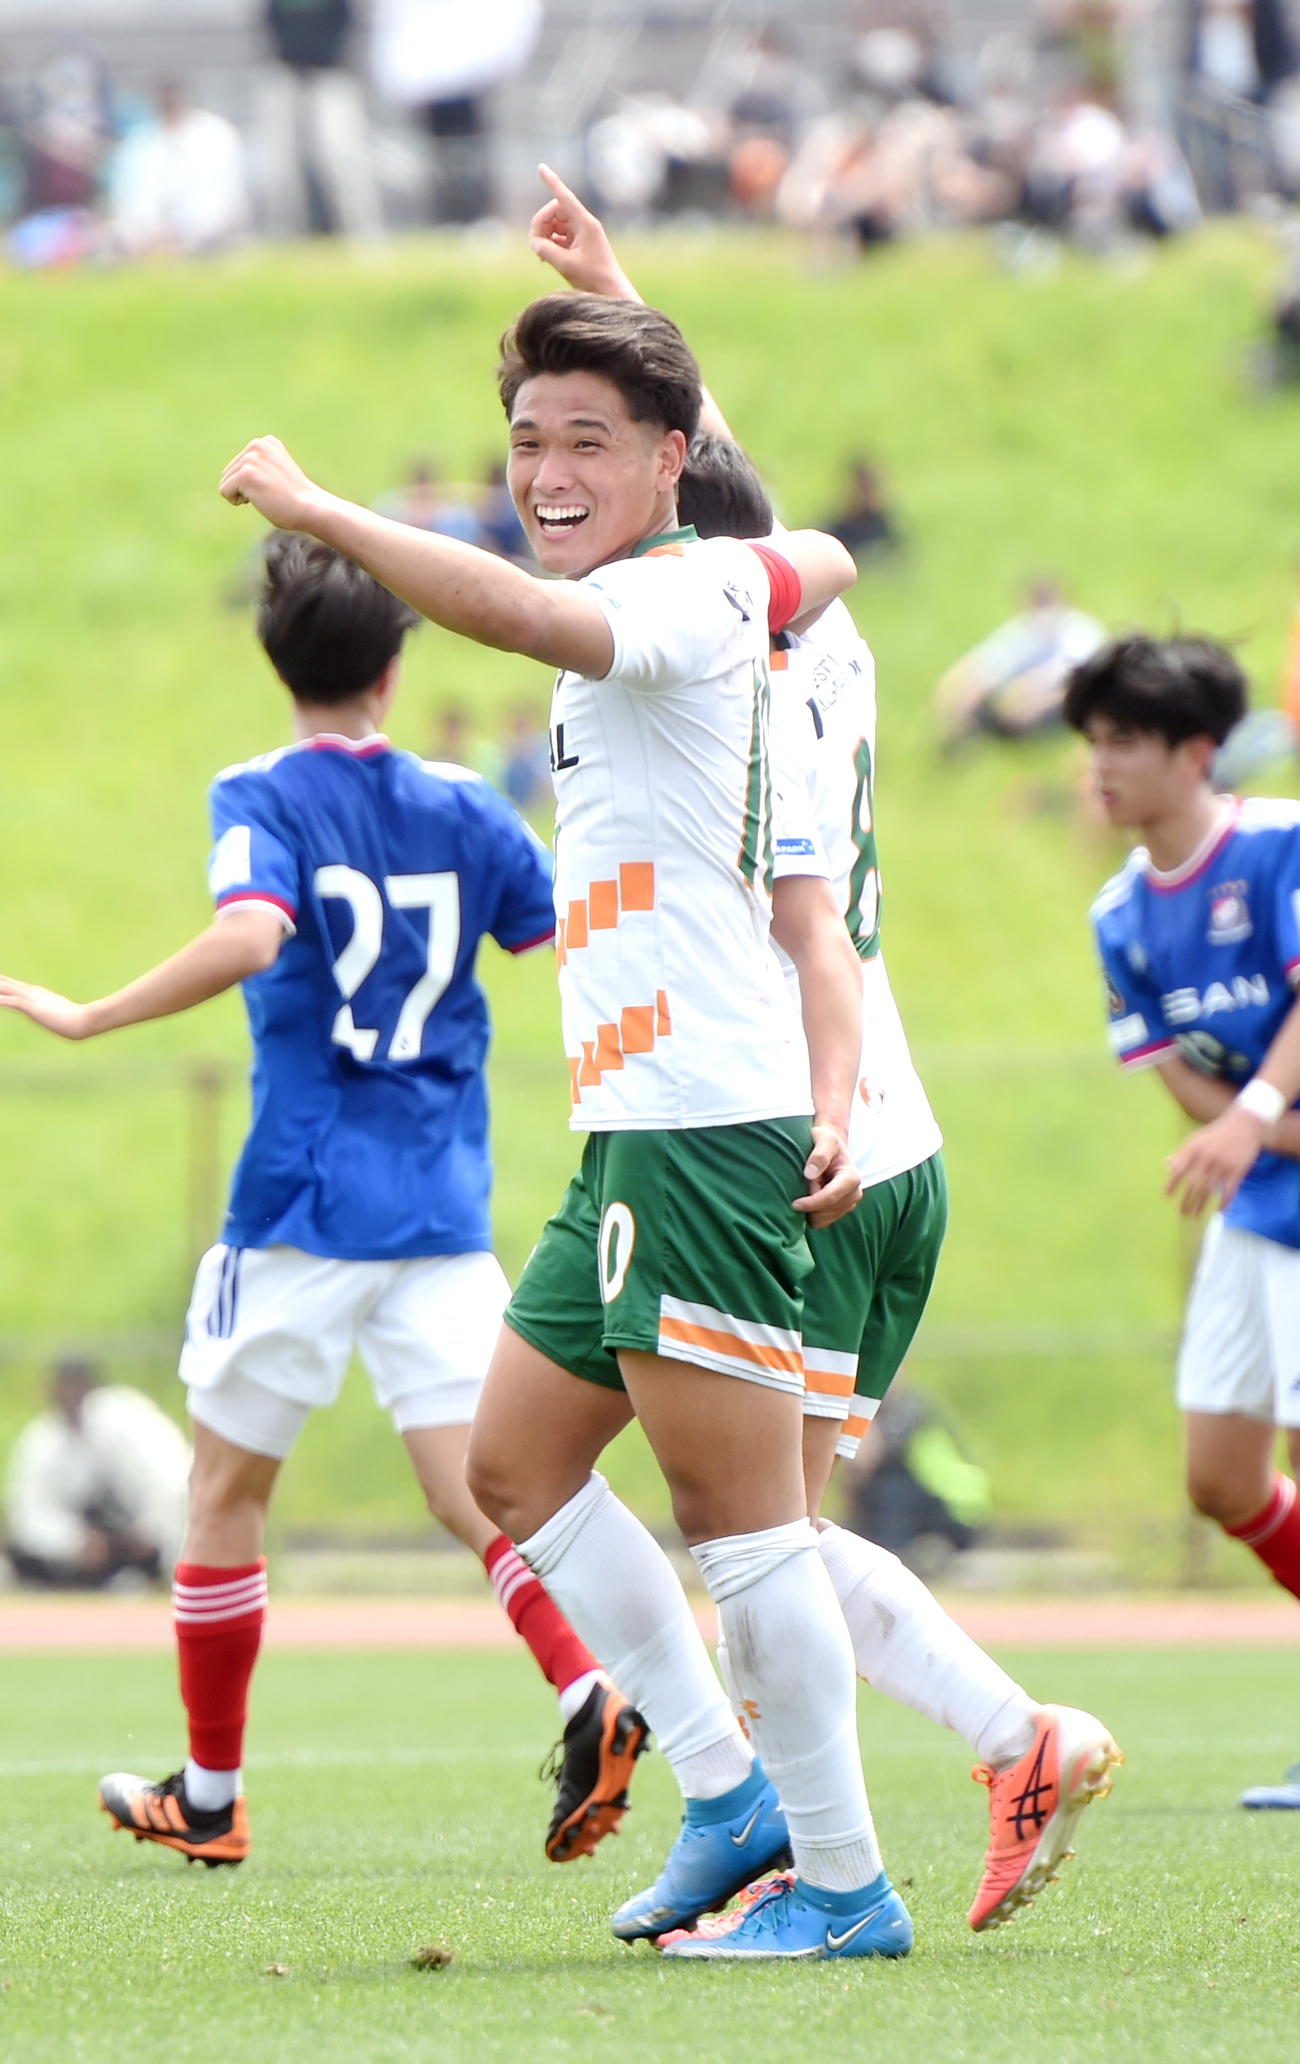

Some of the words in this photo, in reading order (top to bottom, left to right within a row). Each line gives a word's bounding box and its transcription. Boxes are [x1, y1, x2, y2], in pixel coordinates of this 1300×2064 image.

[550, 723, 580, 772] L
[313, 864, 461, 1063] 27
[1160, 973, 1271, 1027] SAN
